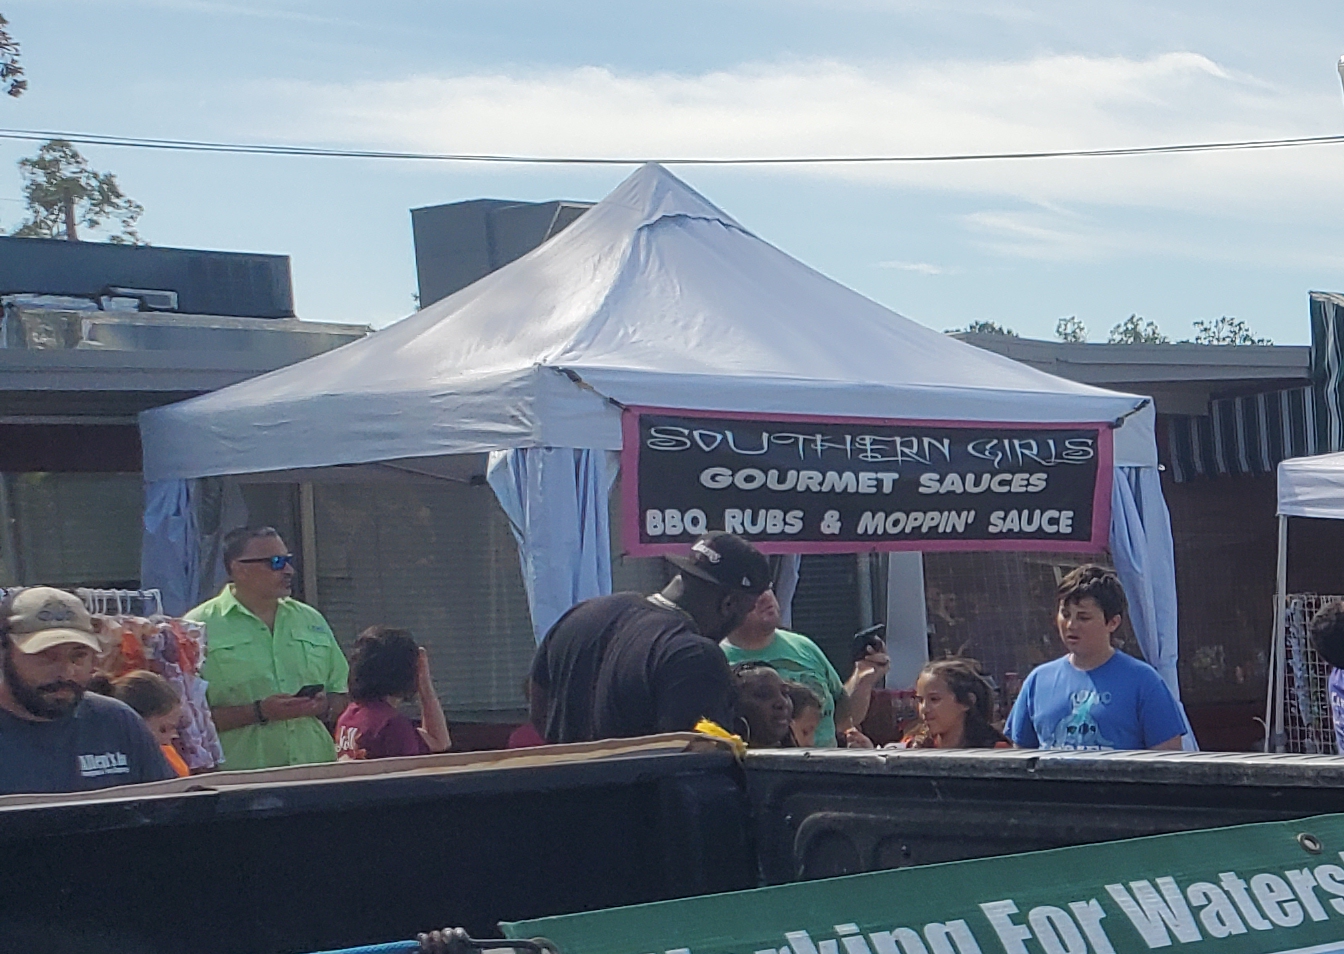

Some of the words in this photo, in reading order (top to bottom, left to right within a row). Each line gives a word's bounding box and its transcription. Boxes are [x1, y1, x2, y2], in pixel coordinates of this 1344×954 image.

[646, 426, 951, 466] SOUTHERN
[967, 438, 1095, 469] GIRLS
[700, 466, 900, 495] GOURMET
[918, 472, 1048, 494] SAUCES
[646, 508, 708, 536] BBQ
[724, 508, 805, 535] RUBS
[820, 509, 843, 535] &
[857, 510, 976, 536] MOPPIN'
[988, 508, 1074, 534] SAUCE
